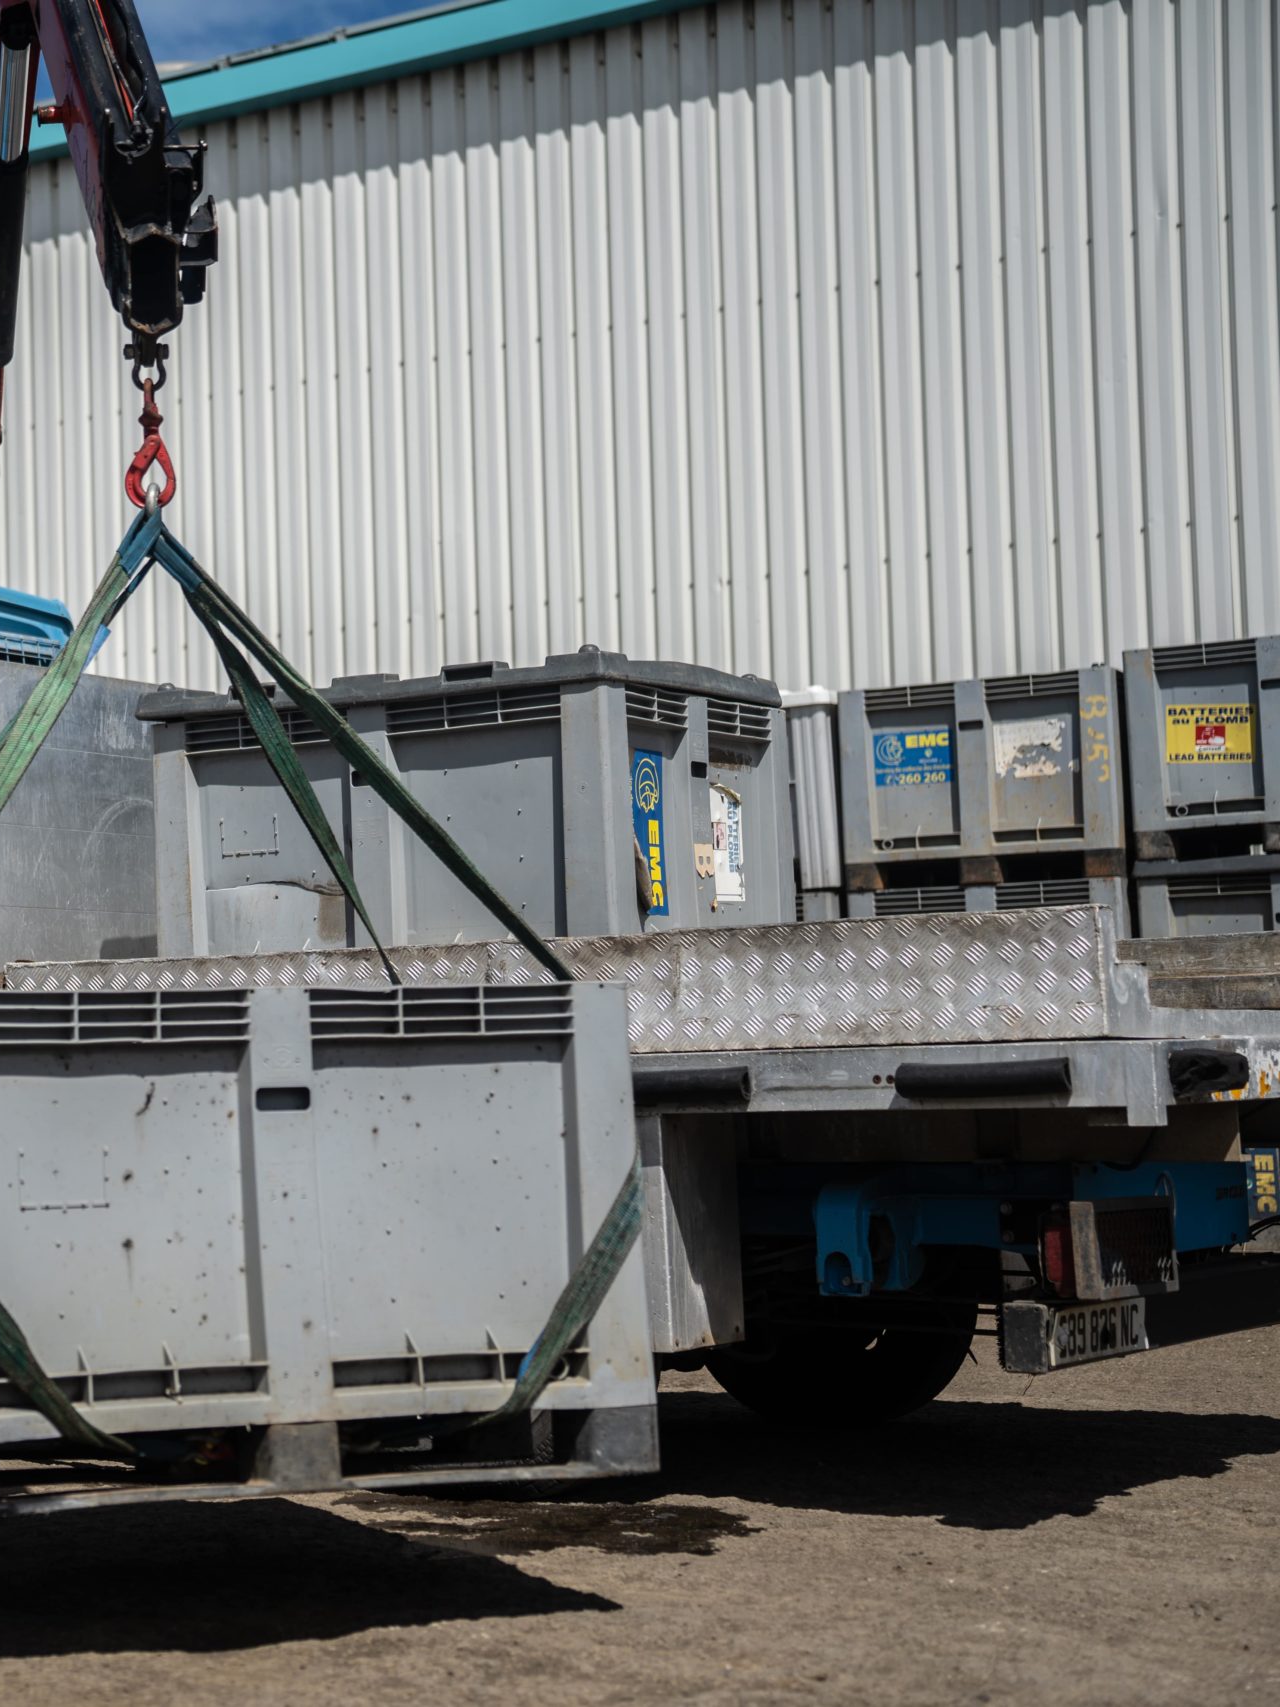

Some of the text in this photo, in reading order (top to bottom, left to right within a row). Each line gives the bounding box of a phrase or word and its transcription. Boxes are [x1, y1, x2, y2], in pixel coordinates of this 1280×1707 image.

[1168, 706, 1254, 716] BATTERIES
[1195, 716, 1249, 724] PLOMB
[905, 732, 949, 749] EMC
[1169, 752, 1253, 761] LEAD BATTERIES
[899, 771, 946, 785] 260 260
[647, 819, 664, 907] EMC
[1254, 1154, 1278, 1214] EMC
[1120, 1304, 1138, 1348] NC
